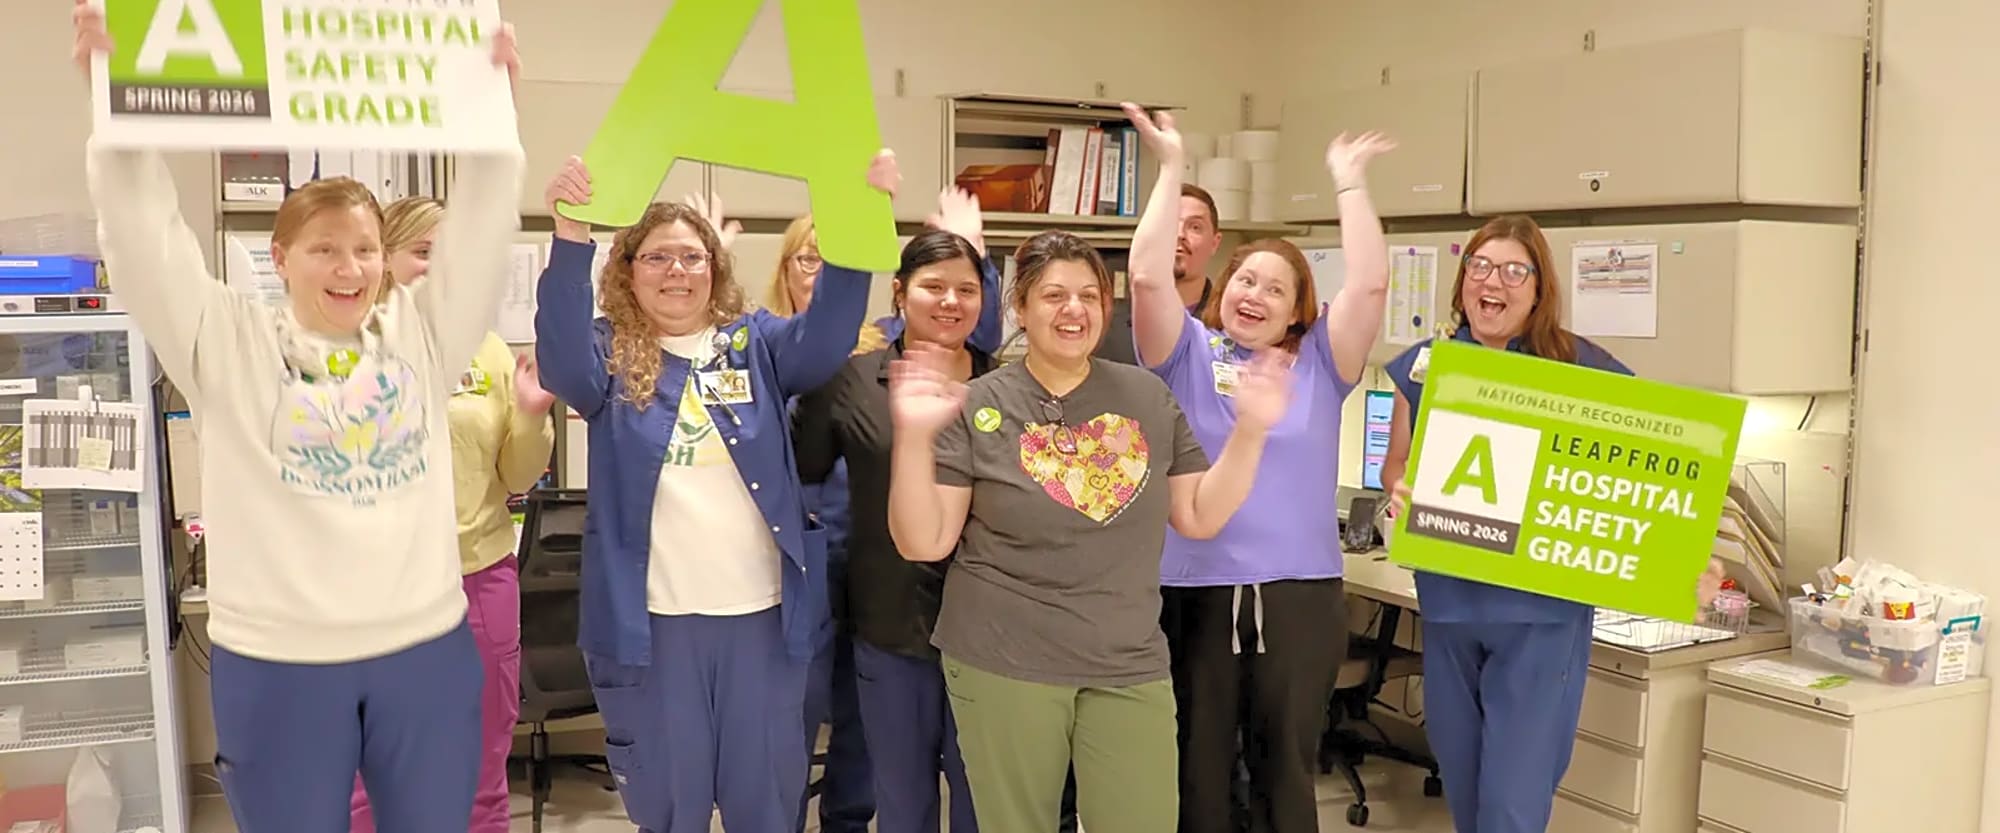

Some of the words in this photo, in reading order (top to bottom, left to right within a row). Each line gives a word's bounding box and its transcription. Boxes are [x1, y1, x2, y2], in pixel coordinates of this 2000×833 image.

[283, 6, 490, 47] HOSPITAL
[286, 49, 437, 85] SAFETY
[125, 87, 202, 112] SPRING
[208, 89, 256, 113] 2026
[289, 91, 442, 127] GRADE
[1477, 386, 1577, 416] NATIONALLY
[1581, 406, 1685, 437] RECOGNIZED
[1441, 433, 1498, 506] A
[1551, 433, 1700, 481] LEAPFROG
[1544, 464, 1698, 519] HOSPITAL
[1416, 511, 1471, 536] SPRING
[1473, 523, 1509, 544] 2026
[1535, 500, 1652, 545] SAFETY
[1528, 536, 1640, 581] GRADE
